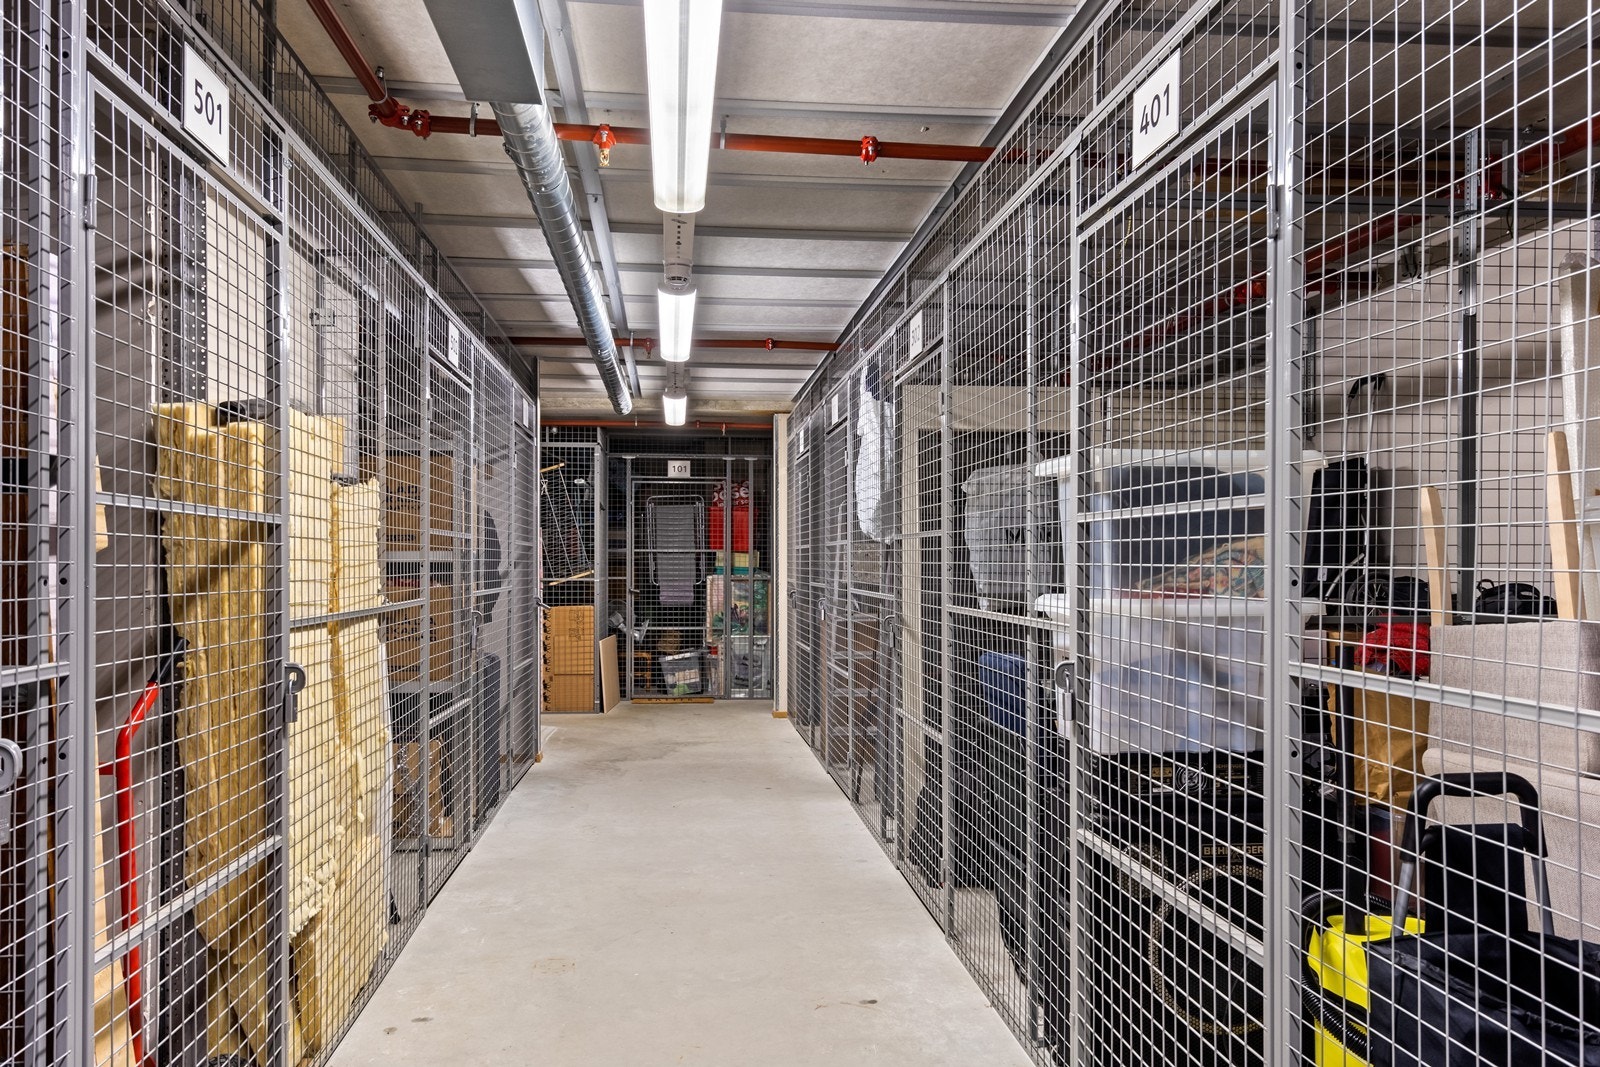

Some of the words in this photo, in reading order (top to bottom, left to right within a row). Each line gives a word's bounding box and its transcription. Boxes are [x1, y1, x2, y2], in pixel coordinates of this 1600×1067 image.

[194, 78, 222, 135] 501
[1140, 83, 1170, 135] 401
[672, 465, 687, 473] 101
[1203, 845, 1264, 855] BEHGER
